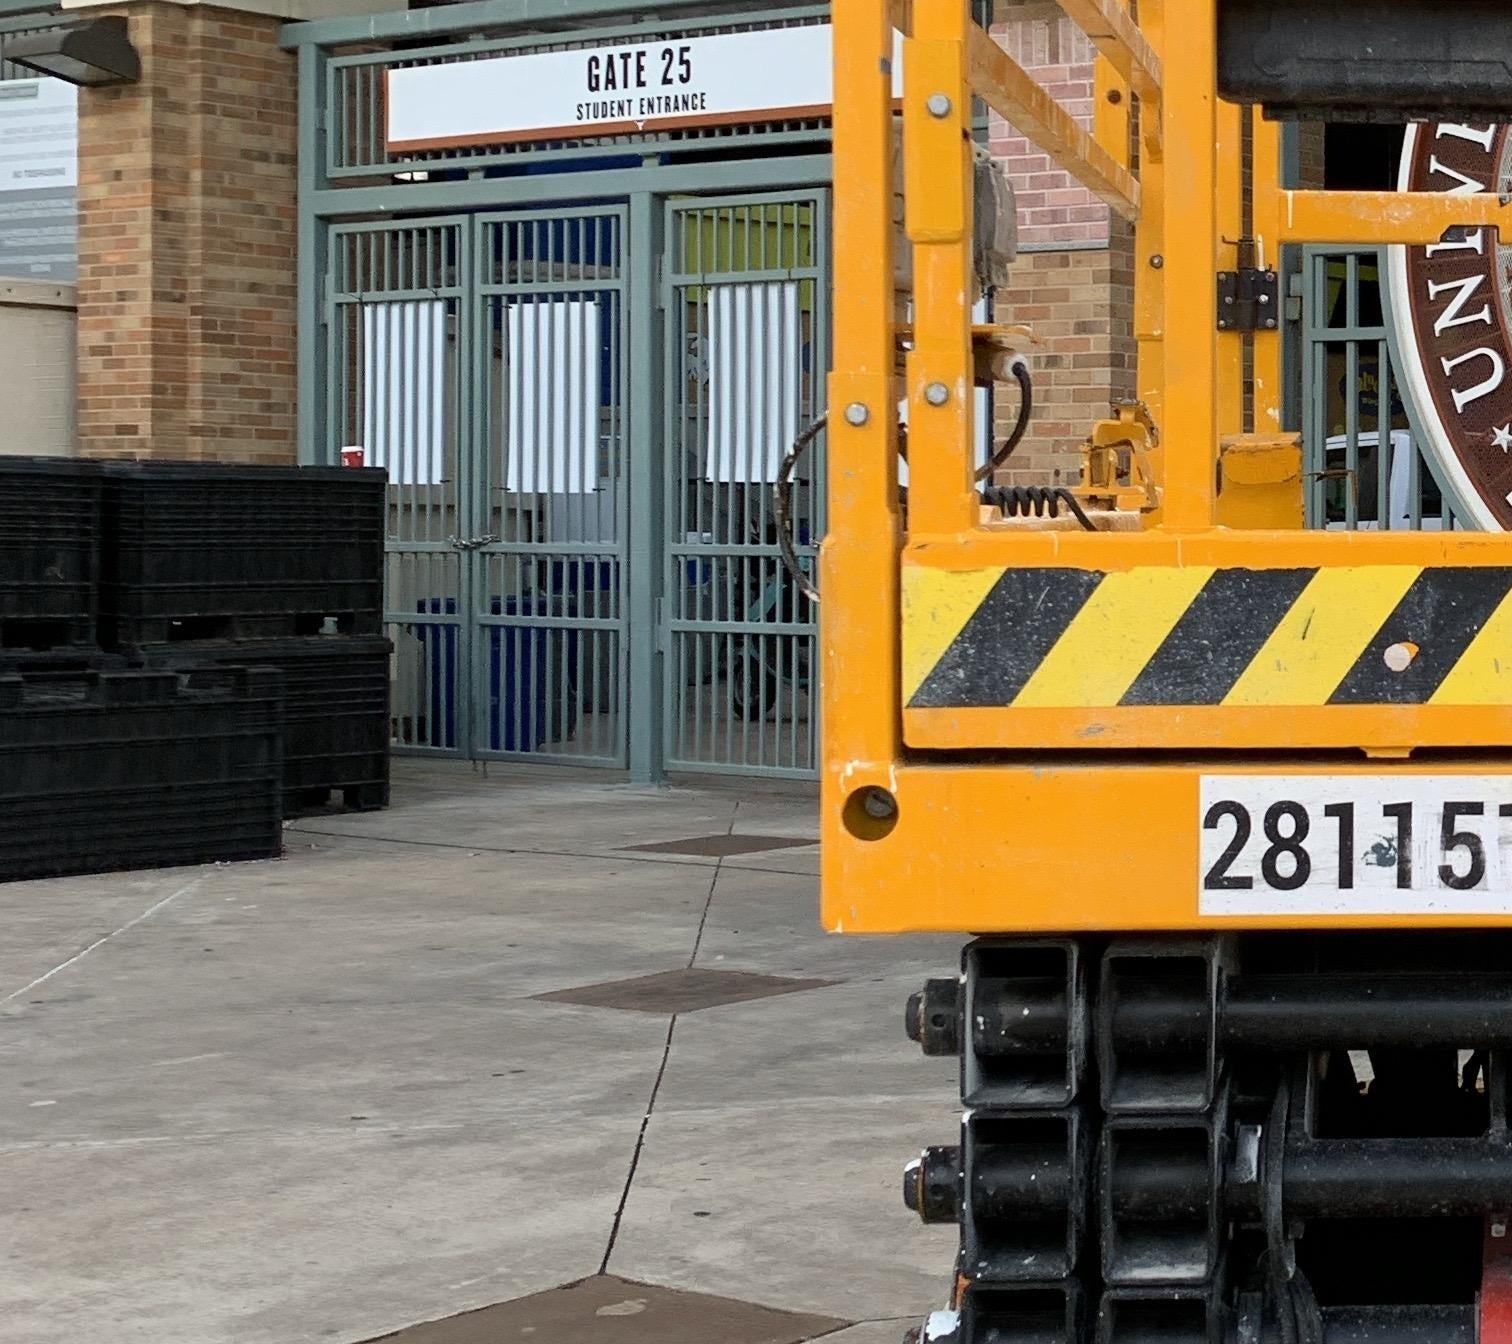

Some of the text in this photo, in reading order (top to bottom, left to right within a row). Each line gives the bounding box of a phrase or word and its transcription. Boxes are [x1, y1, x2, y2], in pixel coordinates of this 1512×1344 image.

[587, 46, 691, 92] GATE 25
[576, 92, 706, 121] STUDENT ENTRANCE
